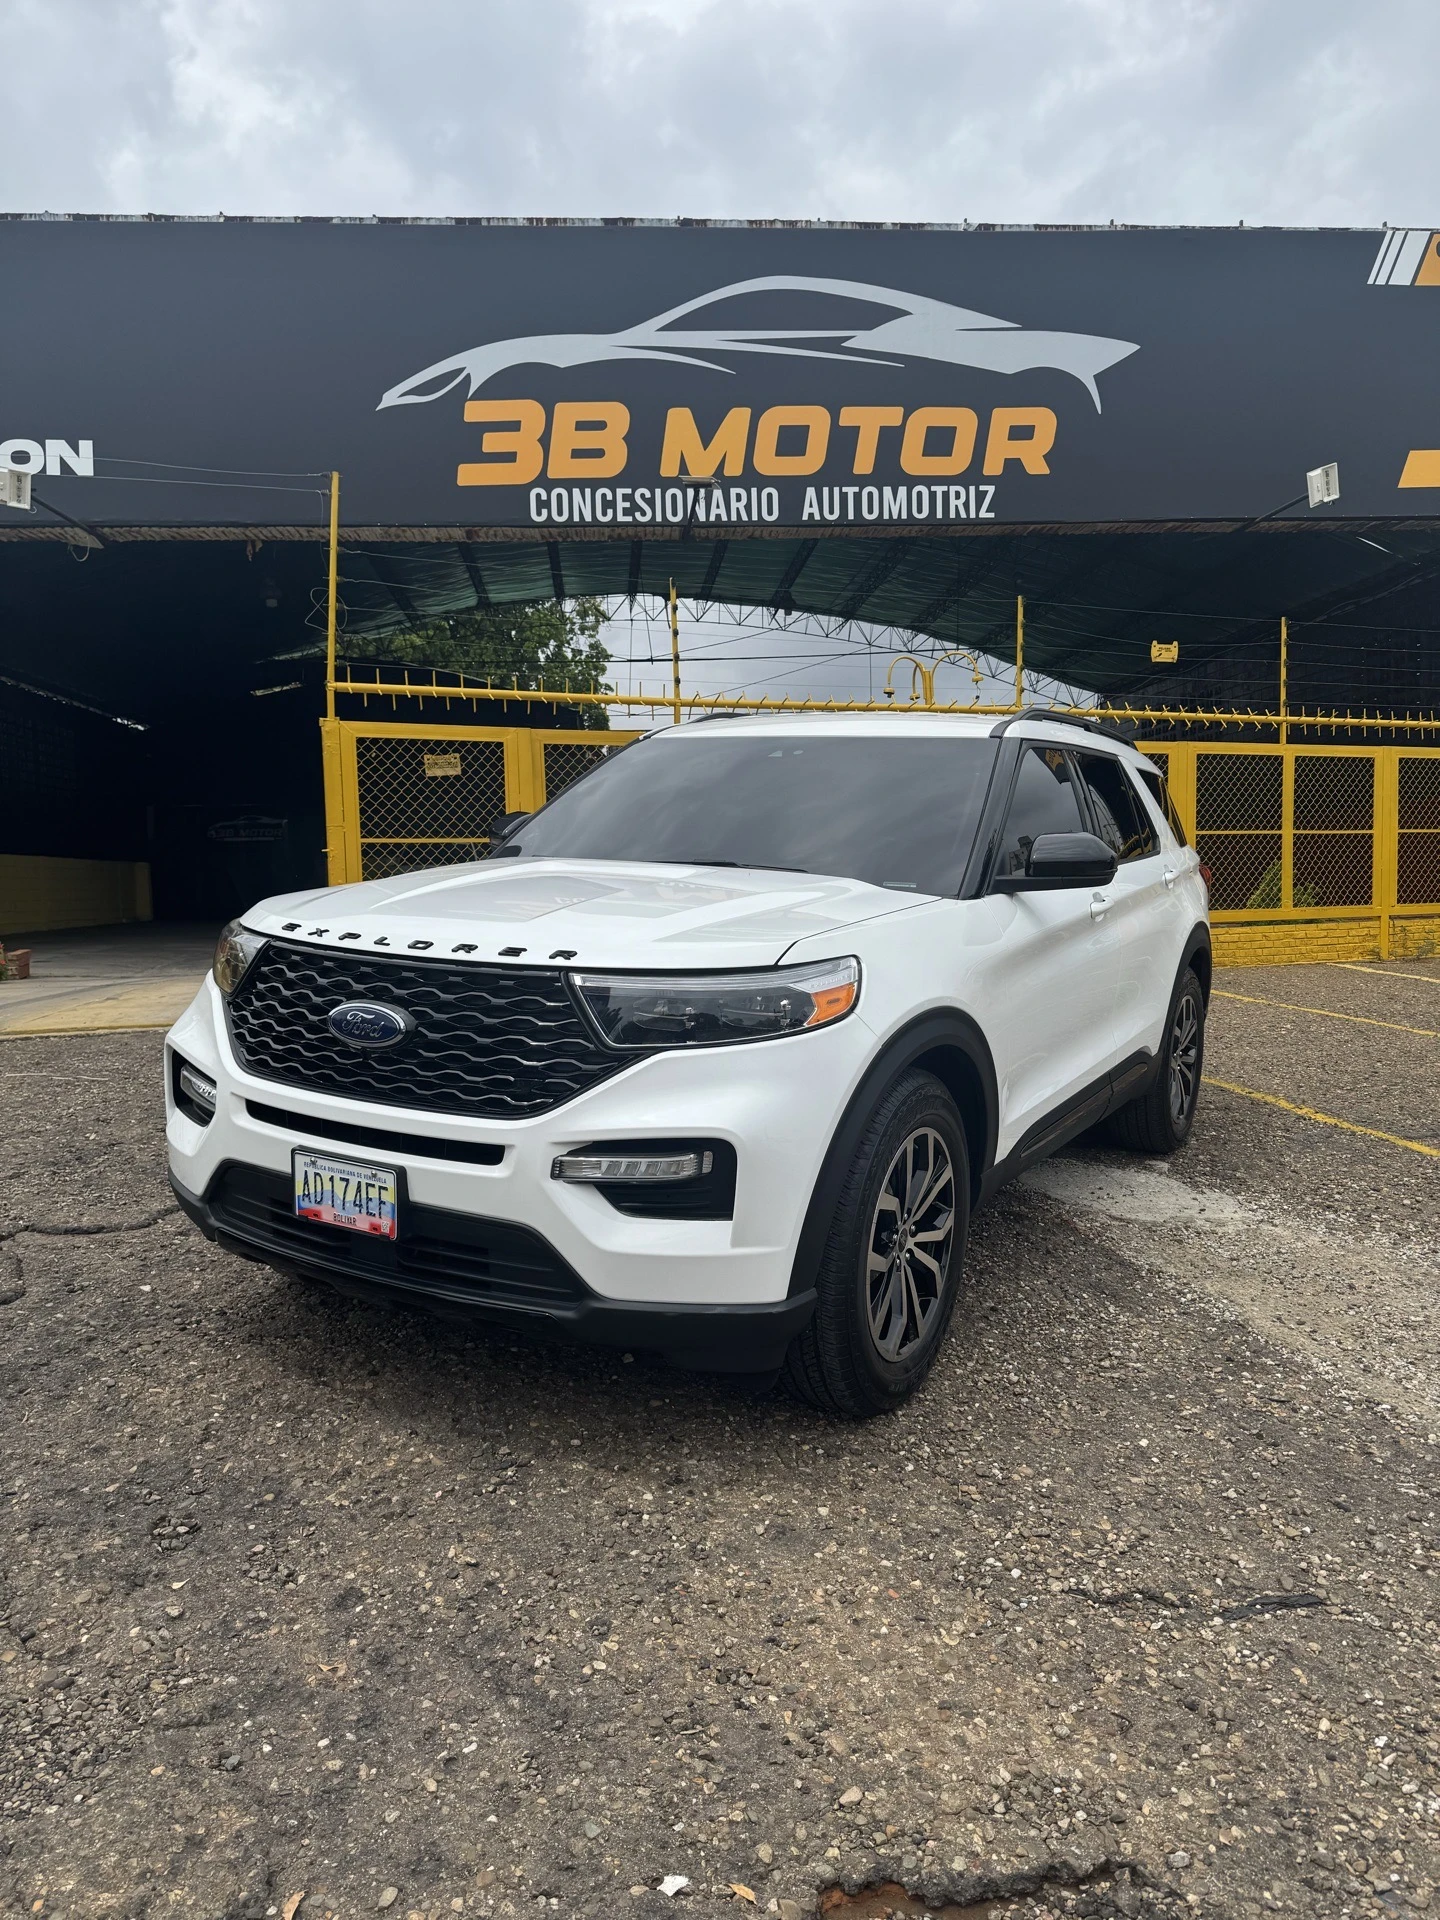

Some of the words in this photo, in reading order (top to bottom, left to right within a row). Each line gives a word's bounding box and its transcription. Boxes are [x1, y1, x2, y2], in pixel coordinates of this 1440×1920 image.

[457, 399, 631, 487] 3B
[659, 405, 1058, 478] MOTOR
[529, 486, 779, 523] CONCESIONARIO
[801, 485, 996, 521] AUTOMOTRIZ
[281, 922, 578, 961] EXPLORER
[341, 1010, 385, 1038] Ford
[302, 1169, 389, 1219] AD174EF
[333, 1212, 357, 1226] BOLIVAR
